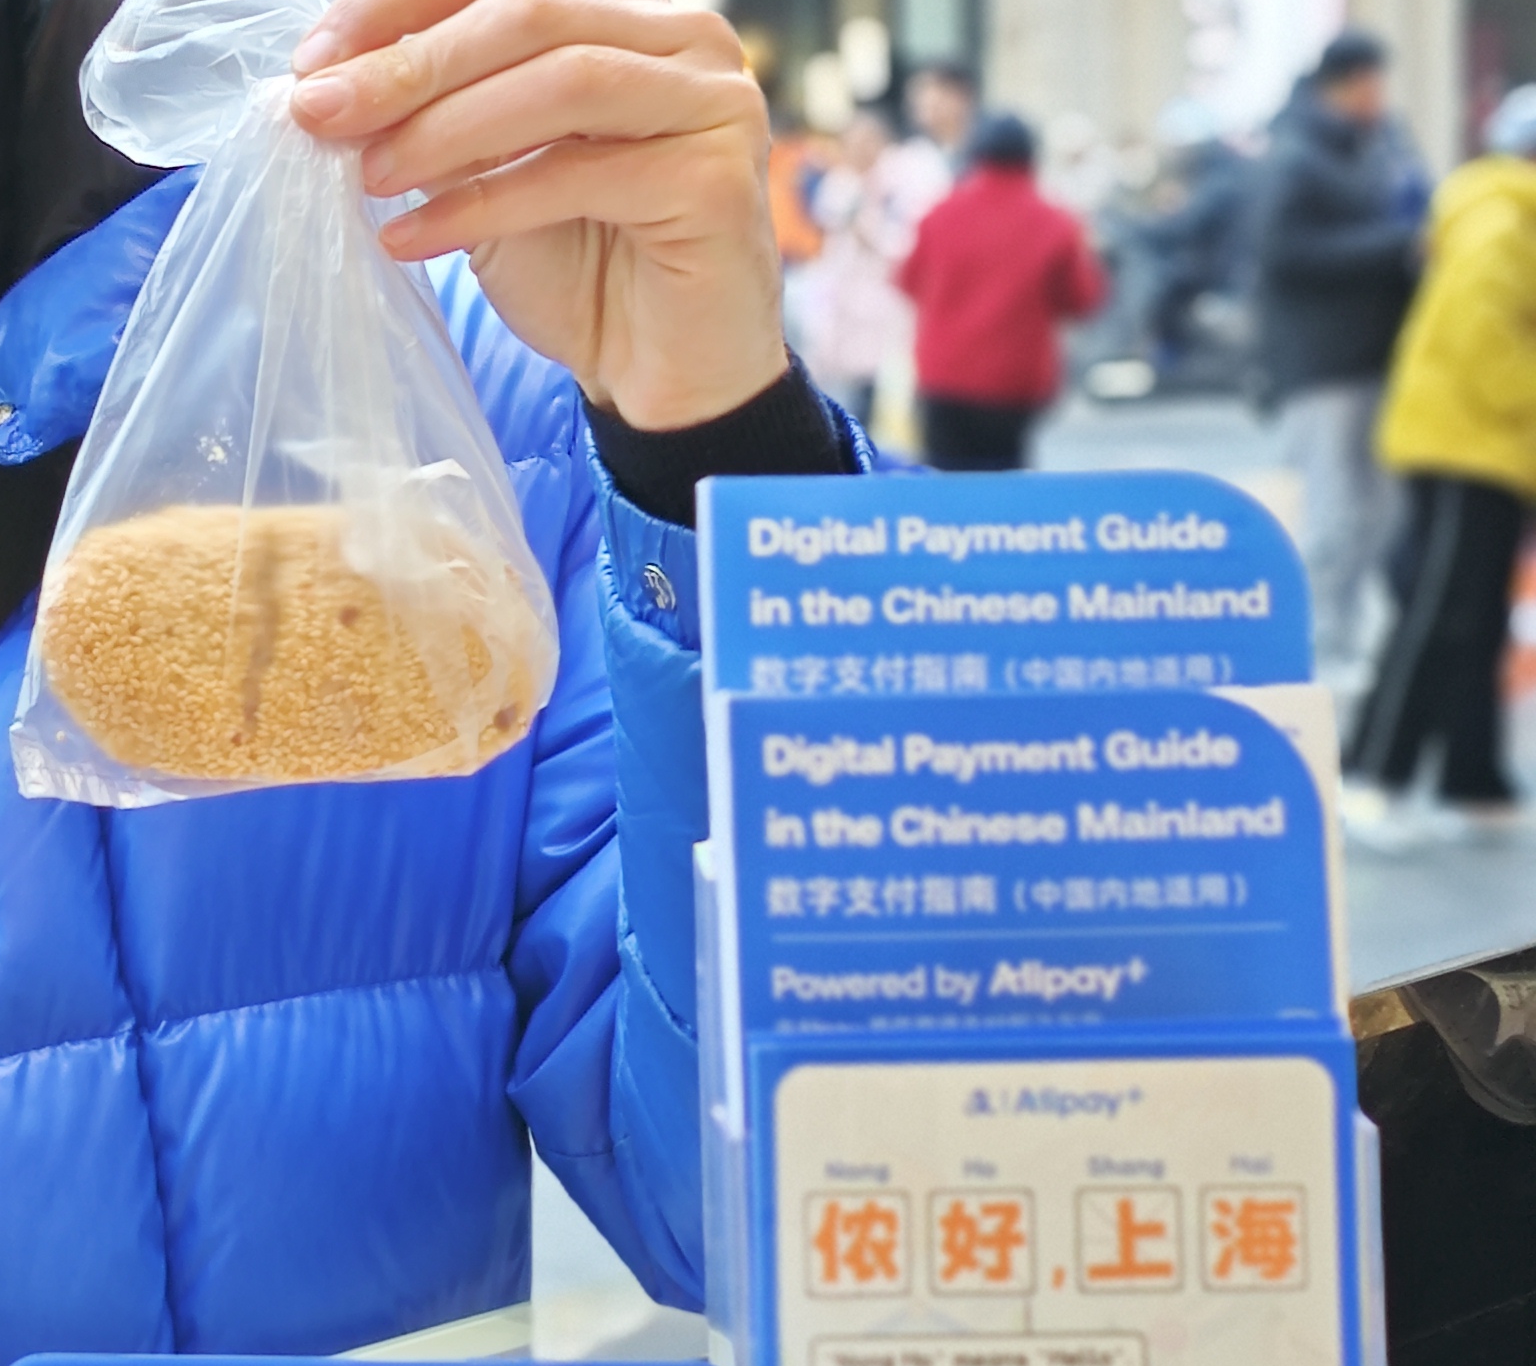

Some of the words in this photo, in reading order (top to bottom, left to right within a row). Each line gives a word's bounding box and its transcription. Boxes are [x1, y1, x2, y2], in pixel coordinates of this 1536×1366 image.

[748, 518, 886, 565] Digital
[897, 514, 1085, 562] Payment
[1096, 511, 1227, 550] Guide
[750, 588, 790, 626] in
[800, 588, 872, 625] the
[881, 584, 1058, 623] Chinese
[1067, 581, 1270, 620] Mainland
[763, 735, 894, 785] Digital
[904, 733, 1096, 784] Payment
[1105, 729, 1239, 770] Guide
[765, 808, 805, 847] in
[812, 808, 882, 846] the
[890, 804, 1066, 845] Chinese
[1076, 799, 1285, 841] Mainland
[772, 966, 926, 1002] Powered
[935, 966, 979, 1004] by
[989, 957, 1149, 1000] Alipay+
[1086, 1155, 1166, 1180] Shang
